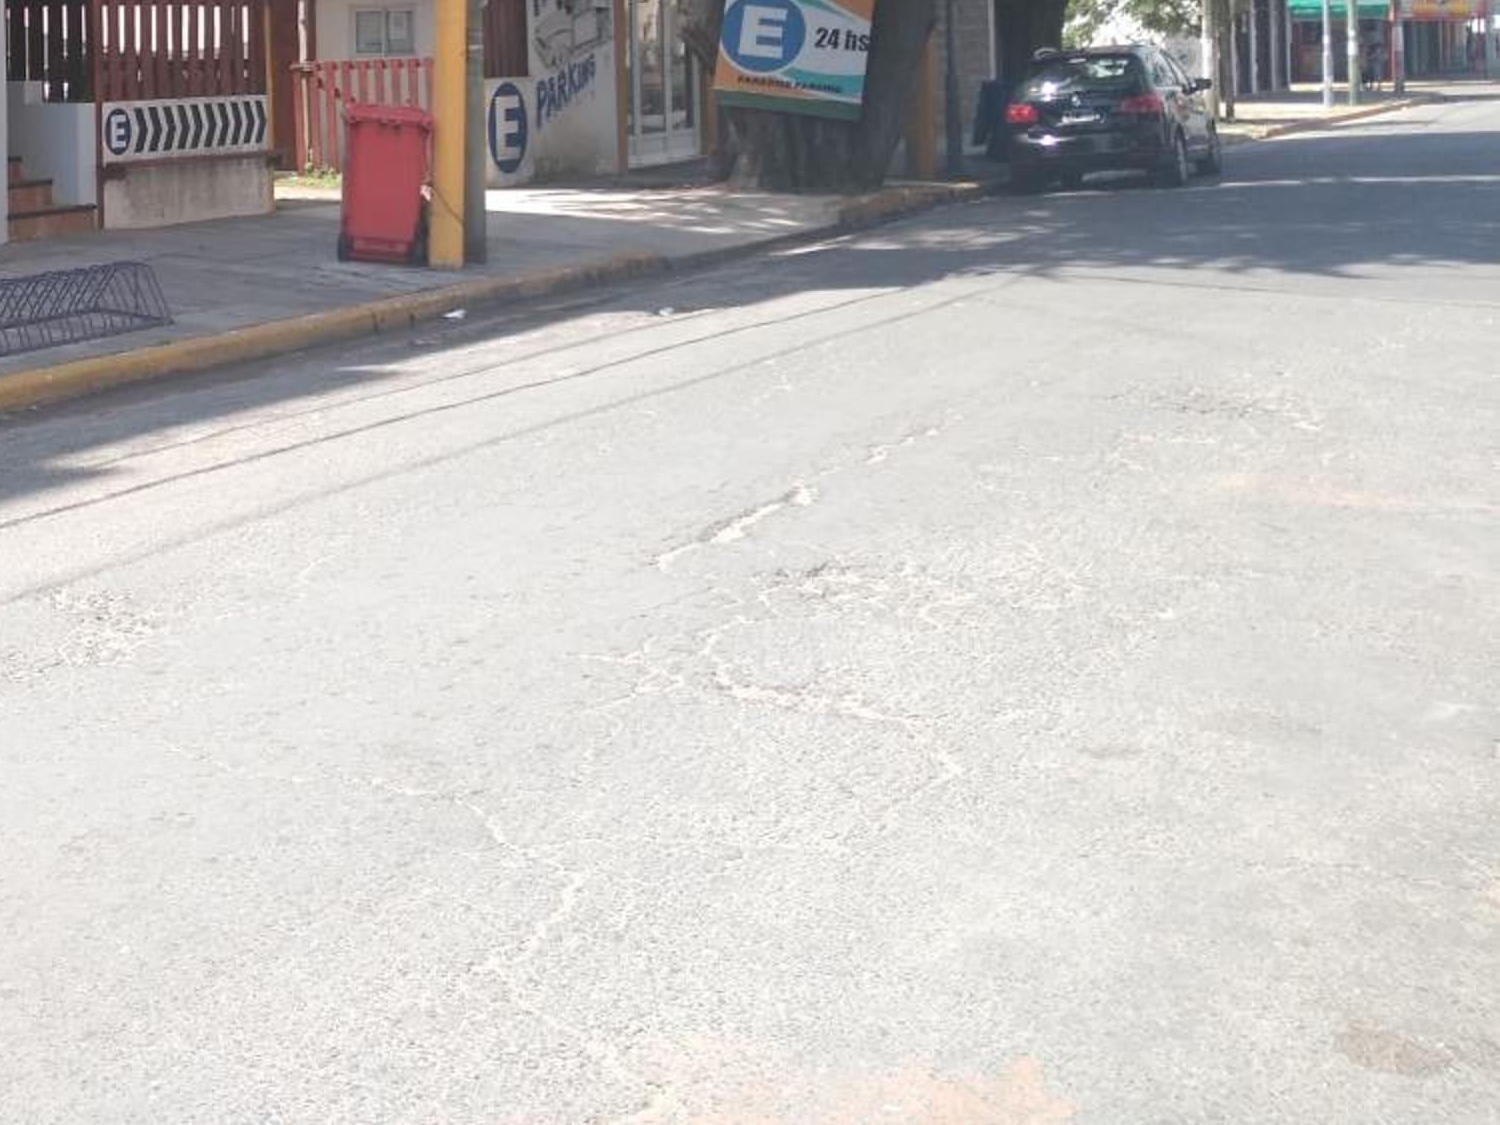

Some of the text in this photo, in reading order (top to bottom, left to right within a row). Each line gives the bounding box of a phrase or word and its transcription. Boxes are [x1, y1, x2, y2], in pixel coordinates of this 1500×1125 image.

[737, 4, 790, 59] E
[814, 27, 840, 49] 24
[110, 114, 128, 149] E
[496, 94, 521, 161] E
